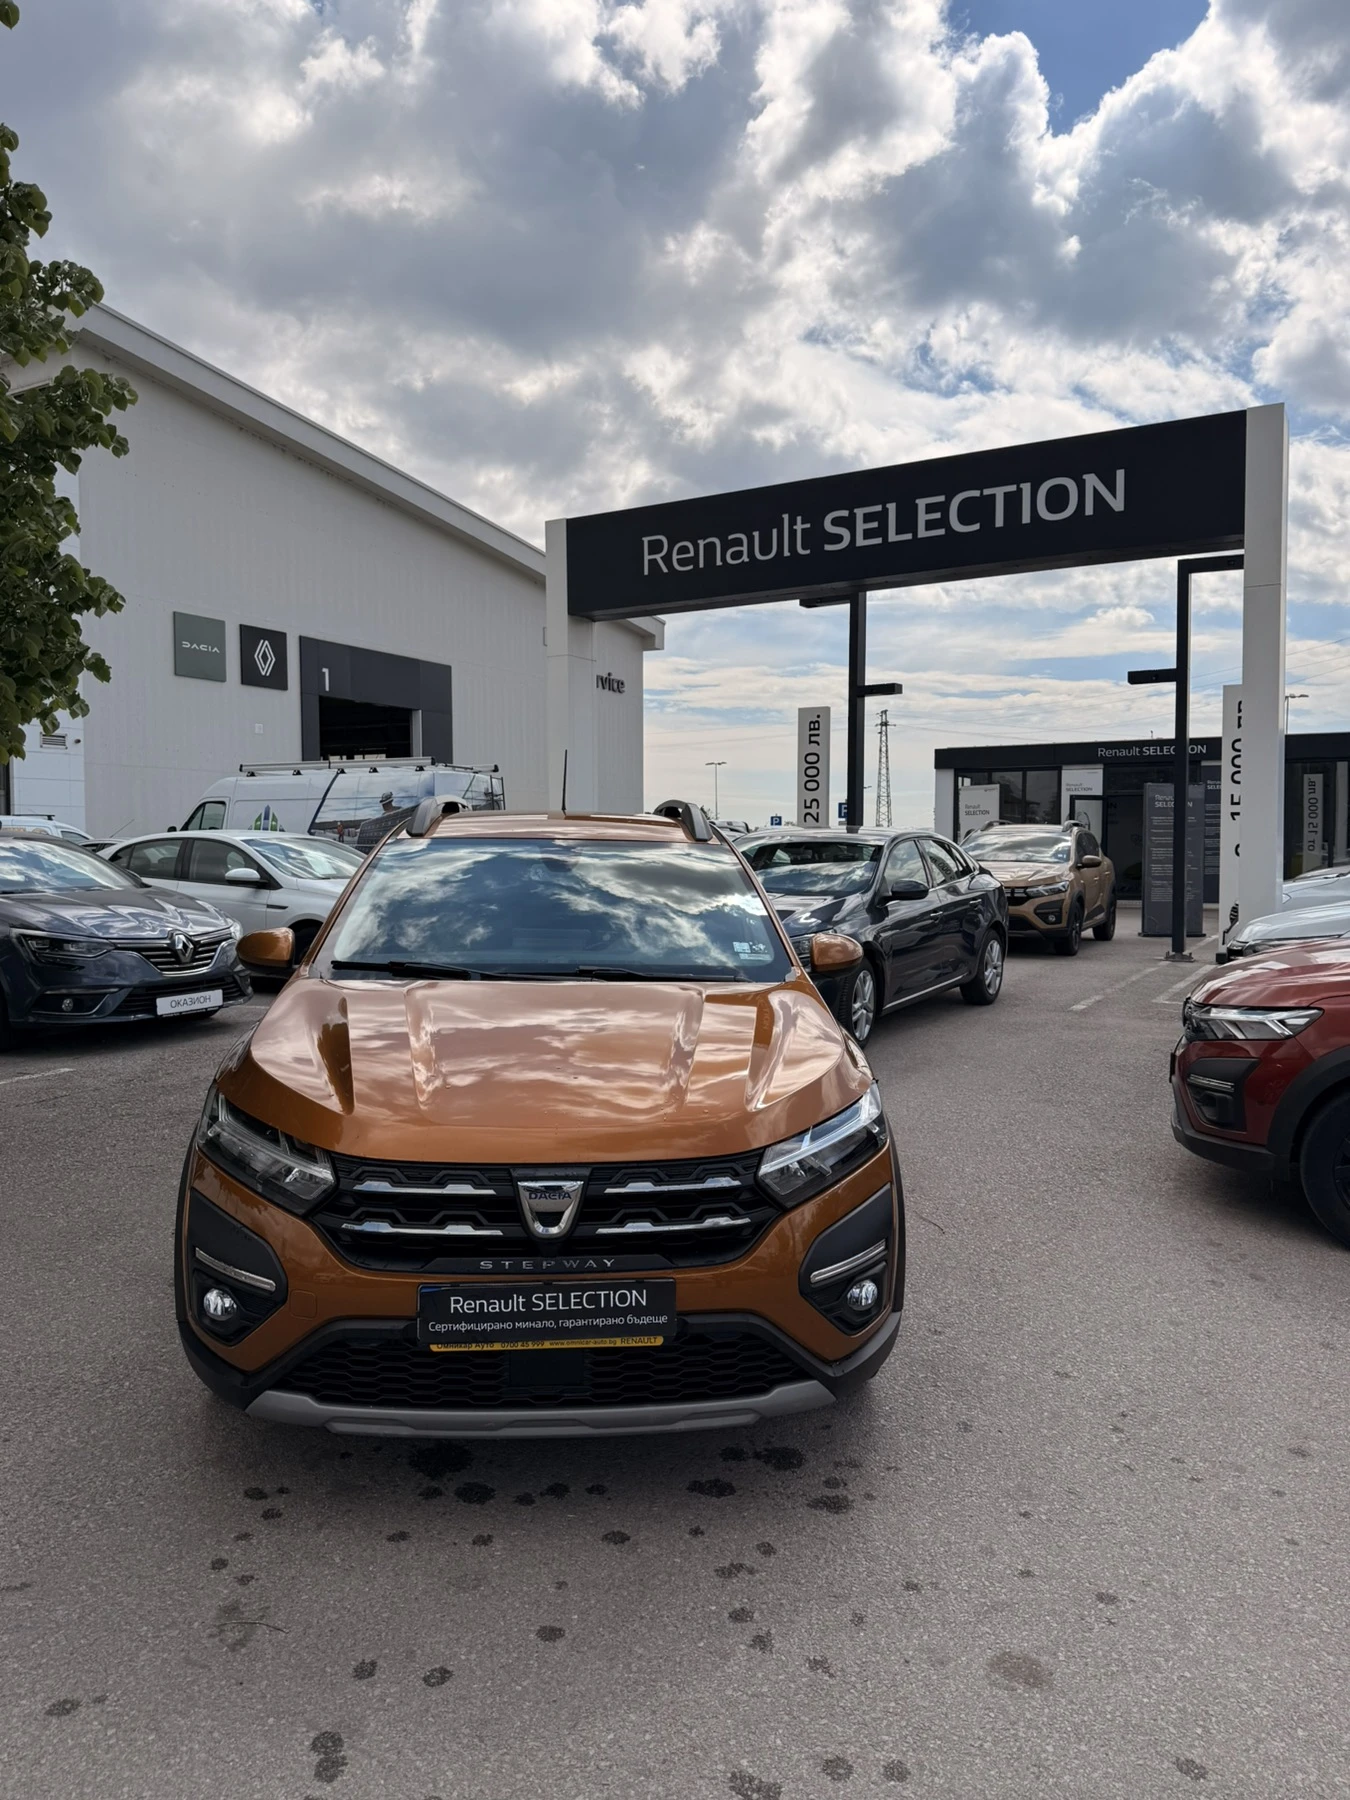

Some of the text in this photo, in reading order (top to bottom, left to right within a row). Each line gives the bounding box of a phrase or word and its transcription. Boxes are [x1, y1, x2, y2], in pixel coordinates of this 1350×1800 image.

[641, 468, 1126, 576] Renault SELECTION
[181, 640, 221, 653] DACIA
[321, 667, 330, 692] 1
[596, 671, 626, 694] rvice
[1097, 744, 1207, 758] Renault SELECON
[803, 714, 821, 823] 25 000 лв.
[772, 817, 780, 826] P
[170, 994, 212, 1009] ОКАЗИОН
[528, 1192, 572, 1200] DACIA
[479, 1258, 616, 1270] STEPWAY
[449, 1289, 648, 1314] Renault SELECTION
[428, 1313, 669, 1333] Сертифицирано минало, гарантирано бъдеще
[474, 1341, 495, 1350] Ауто
[500, 1341, 519, 1349] 0700
[532, 1340, 545, 1348] 999
[620, 1336, 658, 1345] RENAULT
